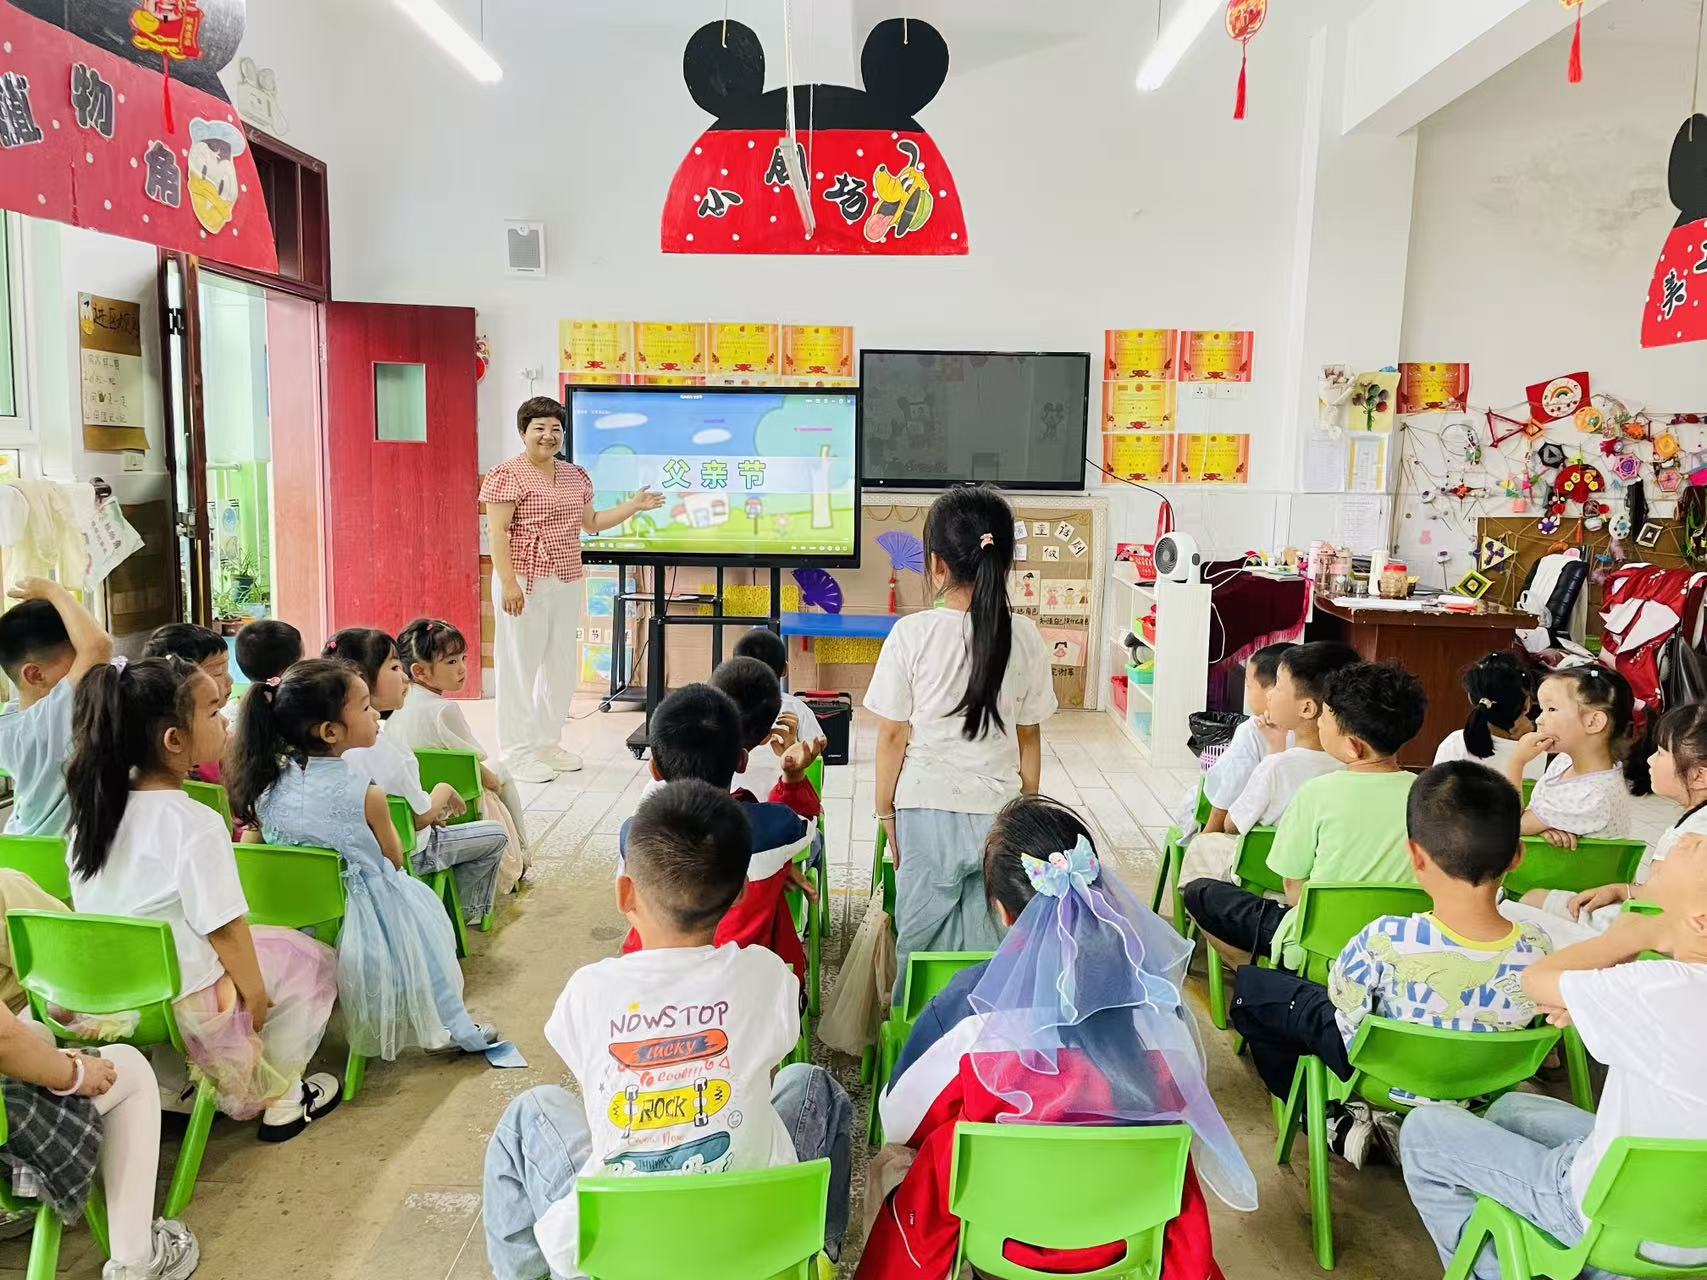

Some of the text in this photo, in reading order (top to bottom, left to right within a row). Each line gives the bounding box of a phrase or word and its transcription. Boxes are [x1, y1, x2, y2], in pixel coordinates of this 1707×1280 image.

[661, 458, 767, 490] 父亲节
[609, 1001, 729, 1039] NOWSTOP
[638, 1094, 688, 1124] ROCK
